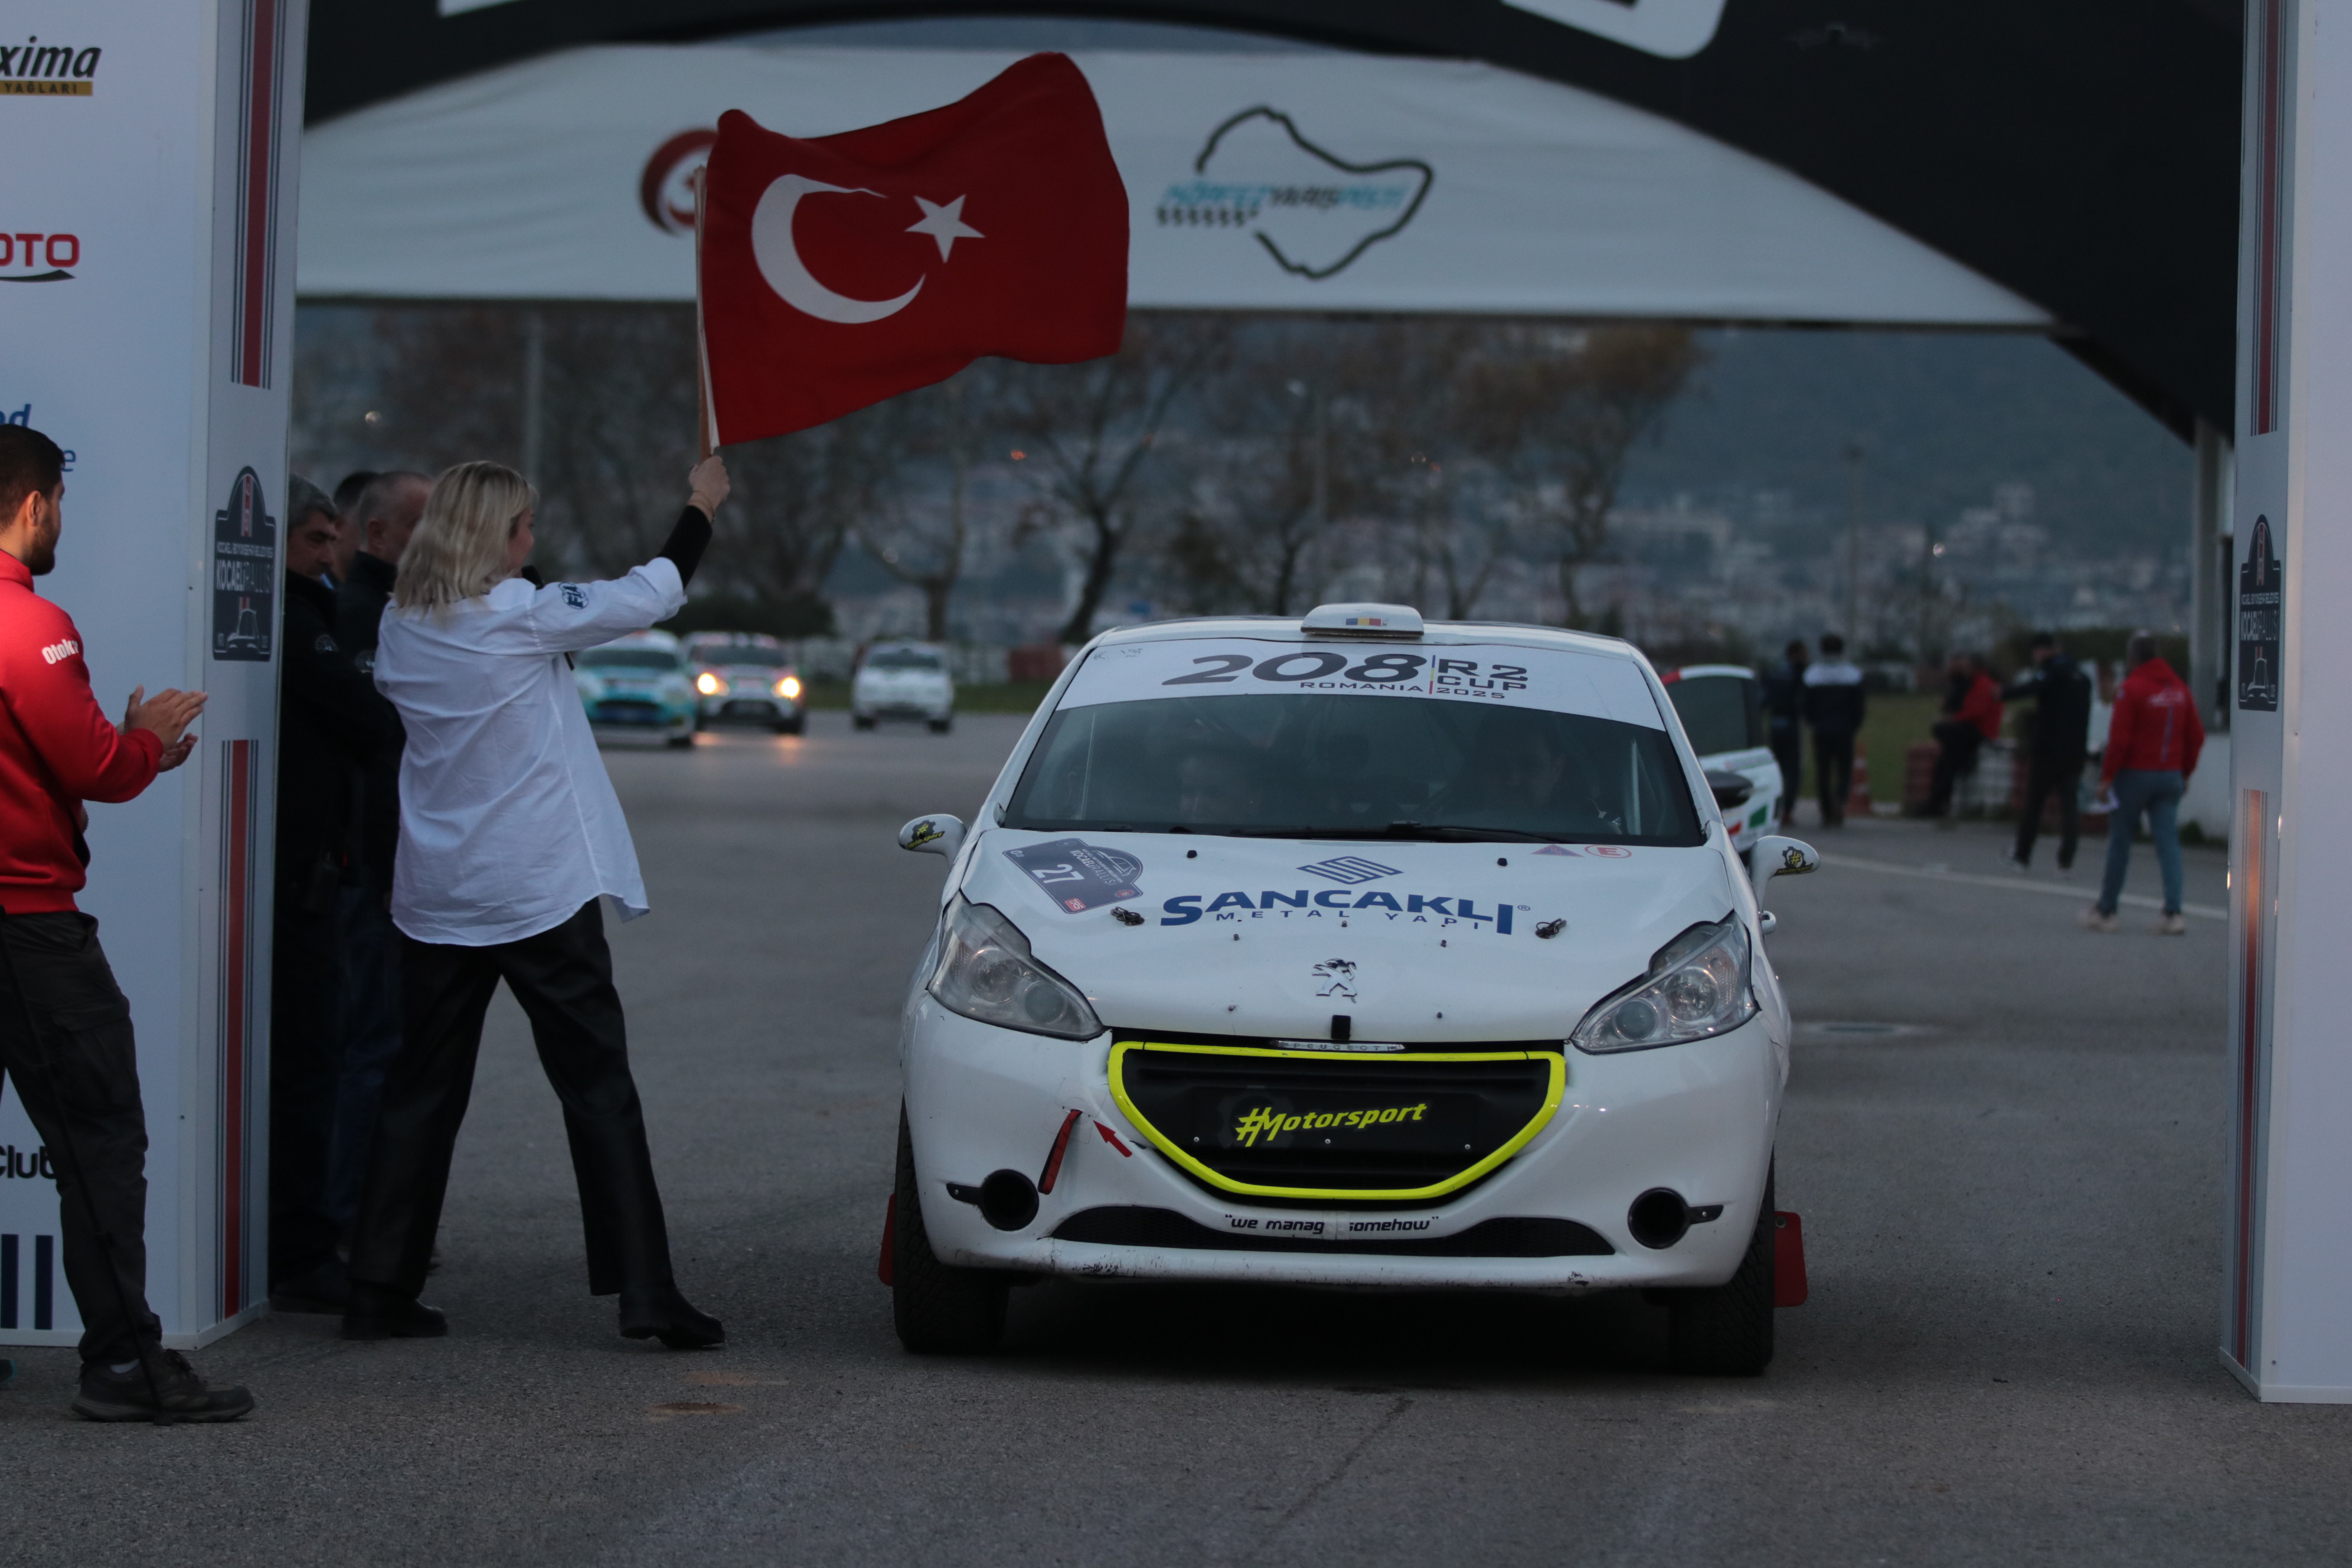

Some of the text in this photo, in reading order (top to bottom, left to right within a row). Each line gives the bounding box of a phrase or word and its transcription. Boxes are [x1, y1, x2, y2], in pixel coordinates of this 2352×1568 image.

[1161, 652, 1527, 685] 208 R2
[1300, 675, 1527, 692] ROMANIA CUP
[1436, 687, 1505, 700] 2025
[1596, 847, 1622, 856] E
[1031, 863, 1085, 884] 27
[1069, 899, 1084, 910] TRS
[1160, 890, 1513, 935] SANCAKLI
[1216, 909, 1480, 930] METAL YAPI
[1293, 1043, 1381, 1051] PEUGEOT
[1234, 1102, 1427, 1147] #Motorsport
[0, 1145, 57, 1180] lub
[1265, 1220, 1325, 1234] manag
